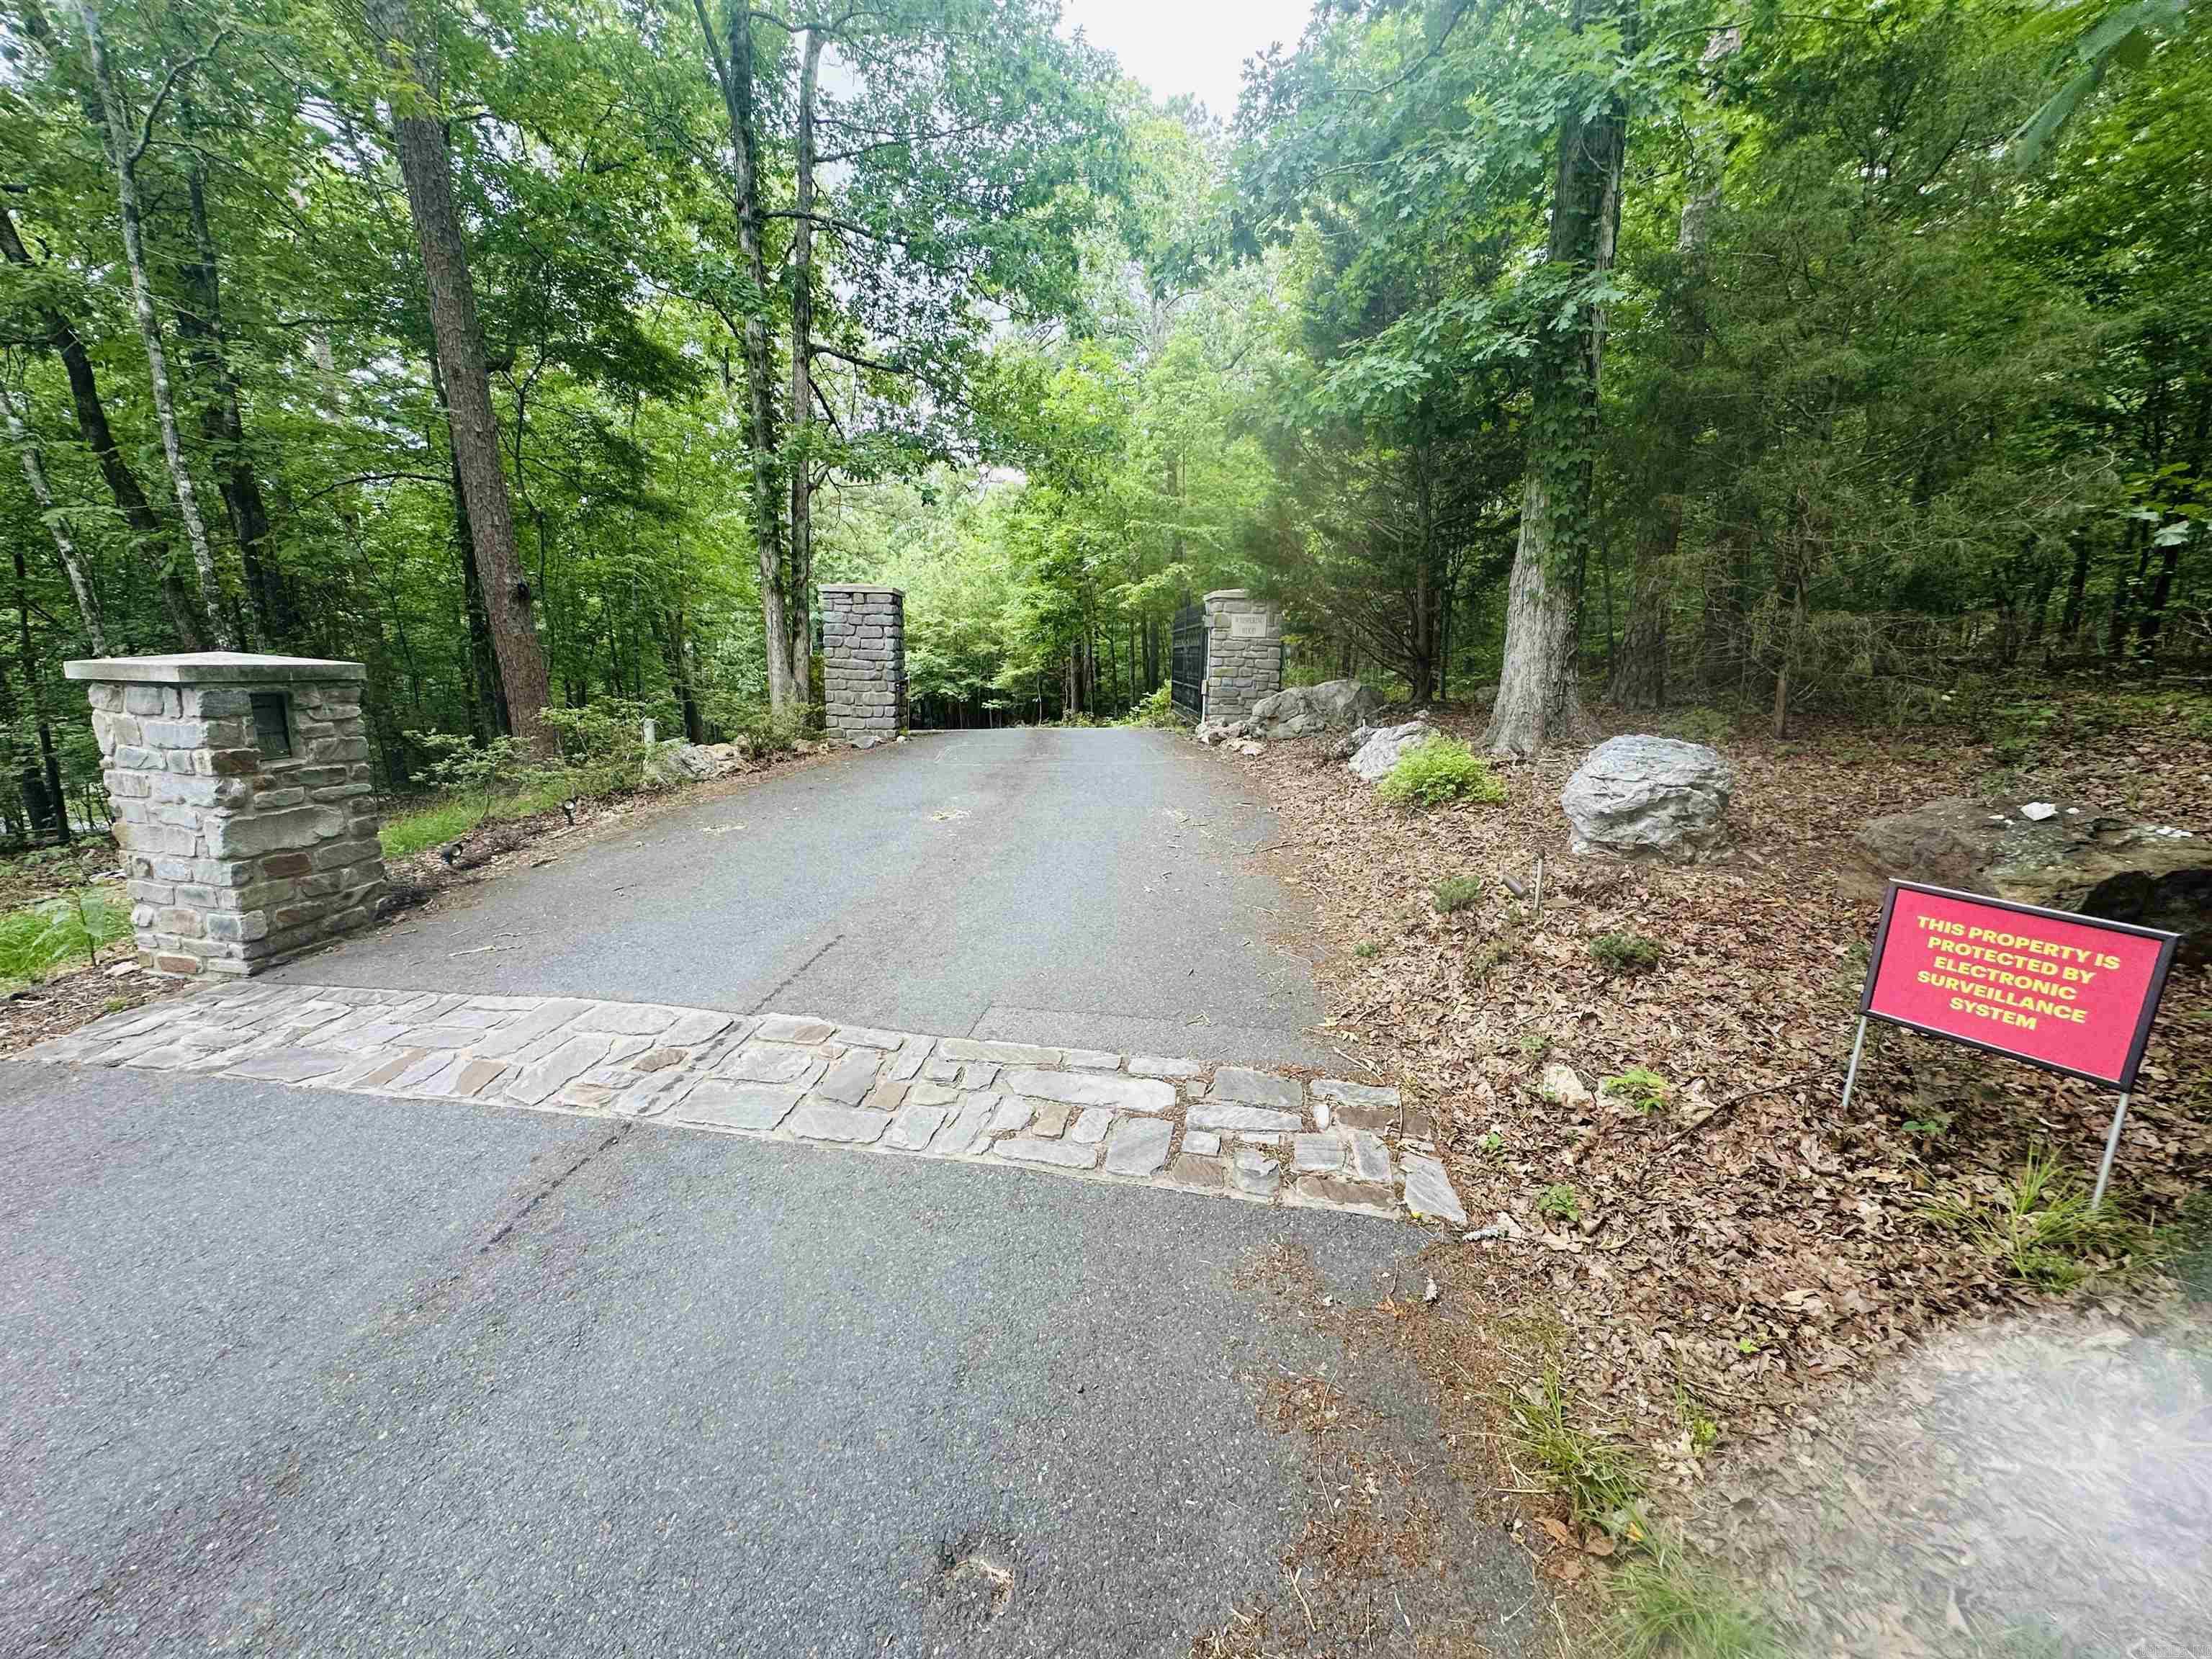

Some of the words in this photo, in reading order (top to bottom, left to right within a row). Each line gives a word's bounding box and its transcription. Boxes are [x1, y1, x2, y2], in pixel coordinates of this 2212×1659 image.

[1917, 916, 1966, 936] THIS
[1968, 927, 2092, 963] PROPERTY
[2094, 953, 2121, 969] IS
[1928, 936, 2059, 975] PROTECTED
[2062, 966, 2097, 984] BY
[1917, 971, 2088, 1023] SURVEILLANCE
[1933, 956, 2077, 1000] ELECTRONIC
[1949, 997, 2038, 1030] SYSTEM
